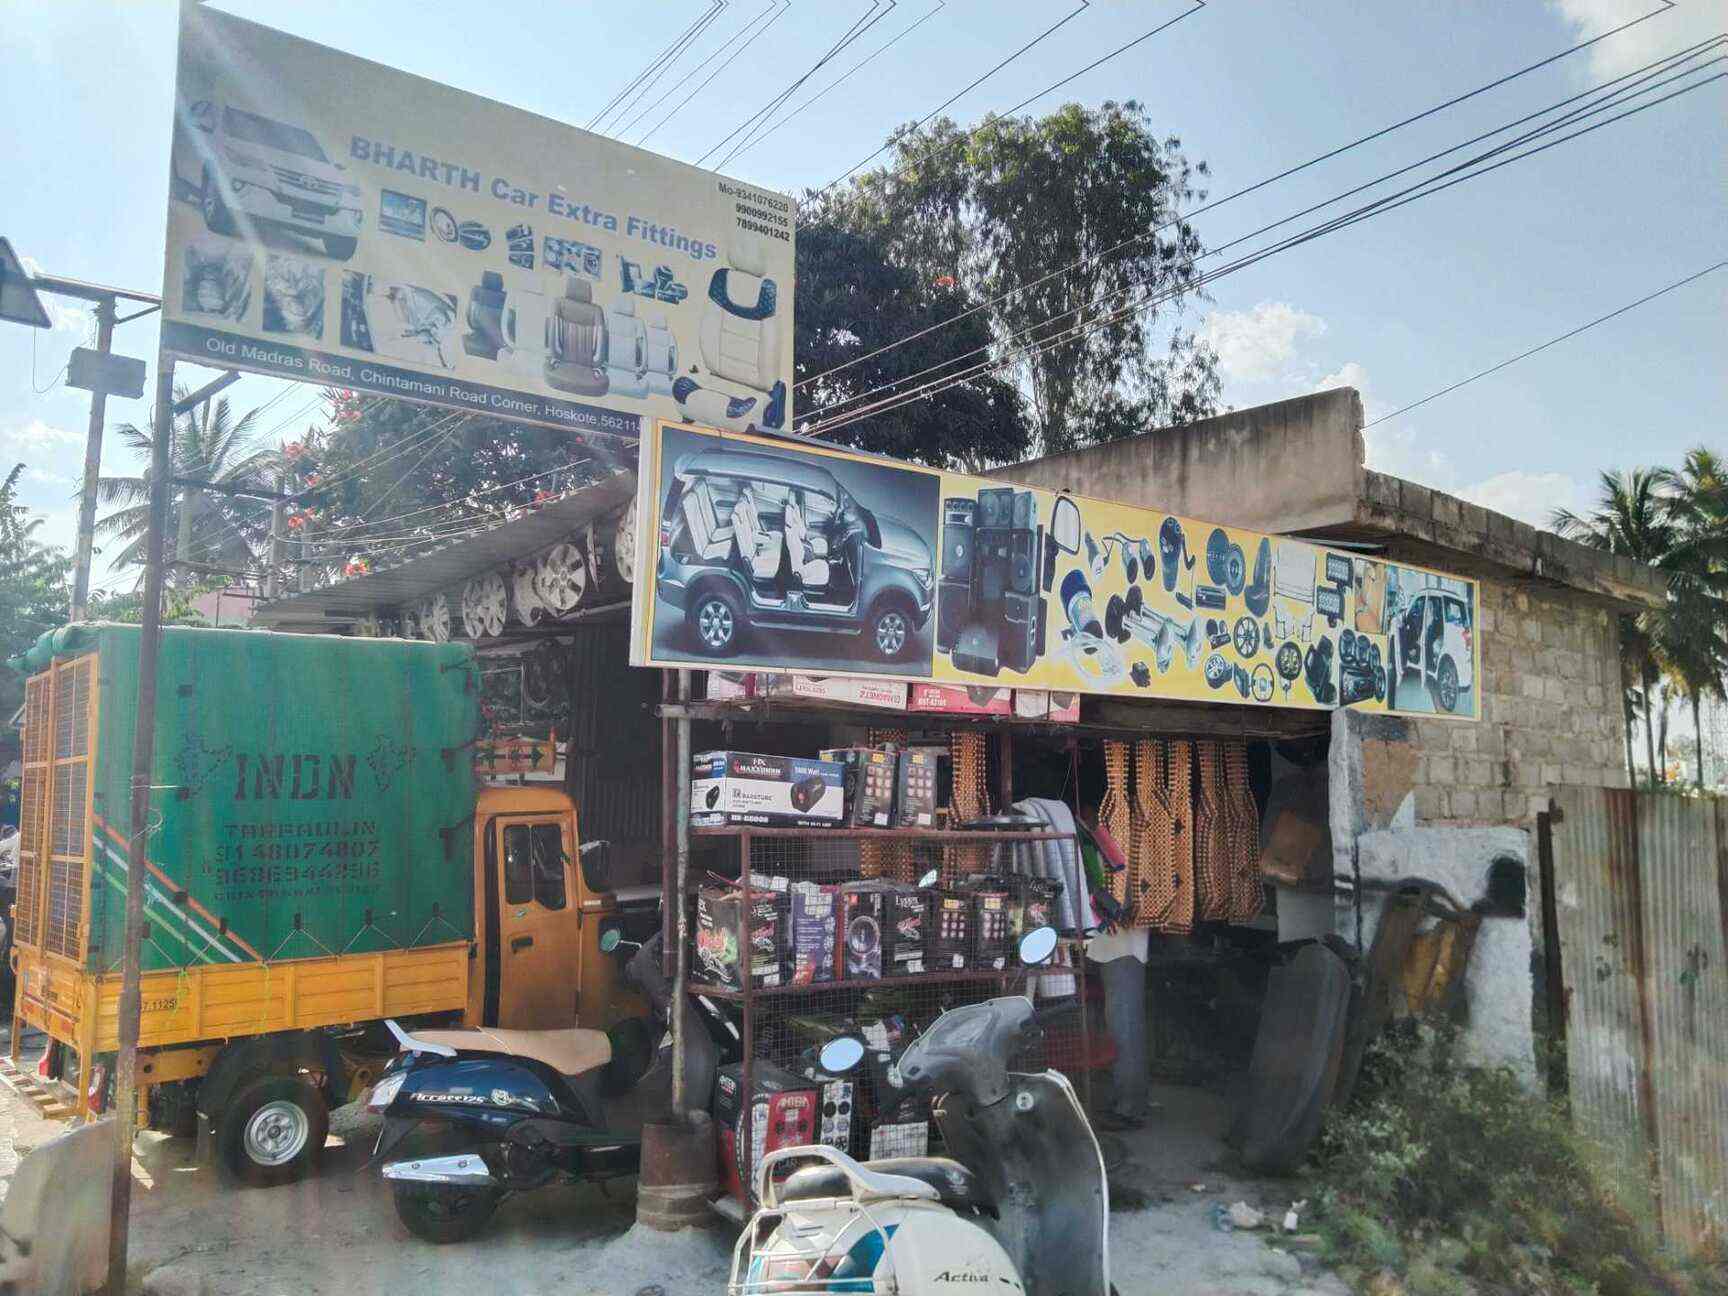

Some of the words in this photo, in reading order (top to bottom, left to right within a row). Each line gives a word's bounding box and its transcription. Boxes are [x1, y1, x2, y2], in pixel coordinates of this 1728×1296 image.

[350, 135, 480, 192] BHARTH
[490, 177, 539, 208] Car
[548, 193, 617, 231] Extra
[626, 215, 718, 260] Fittings
[205, 337, 236, 355] Old
[241, 344, 305, 369] Madras
[308, 356, 356, 381] Road,
[359, 368, 446, 396] Chintamani
[449, 385, 488, 405] Road
[933, 1271, 989, 1282] Activa
